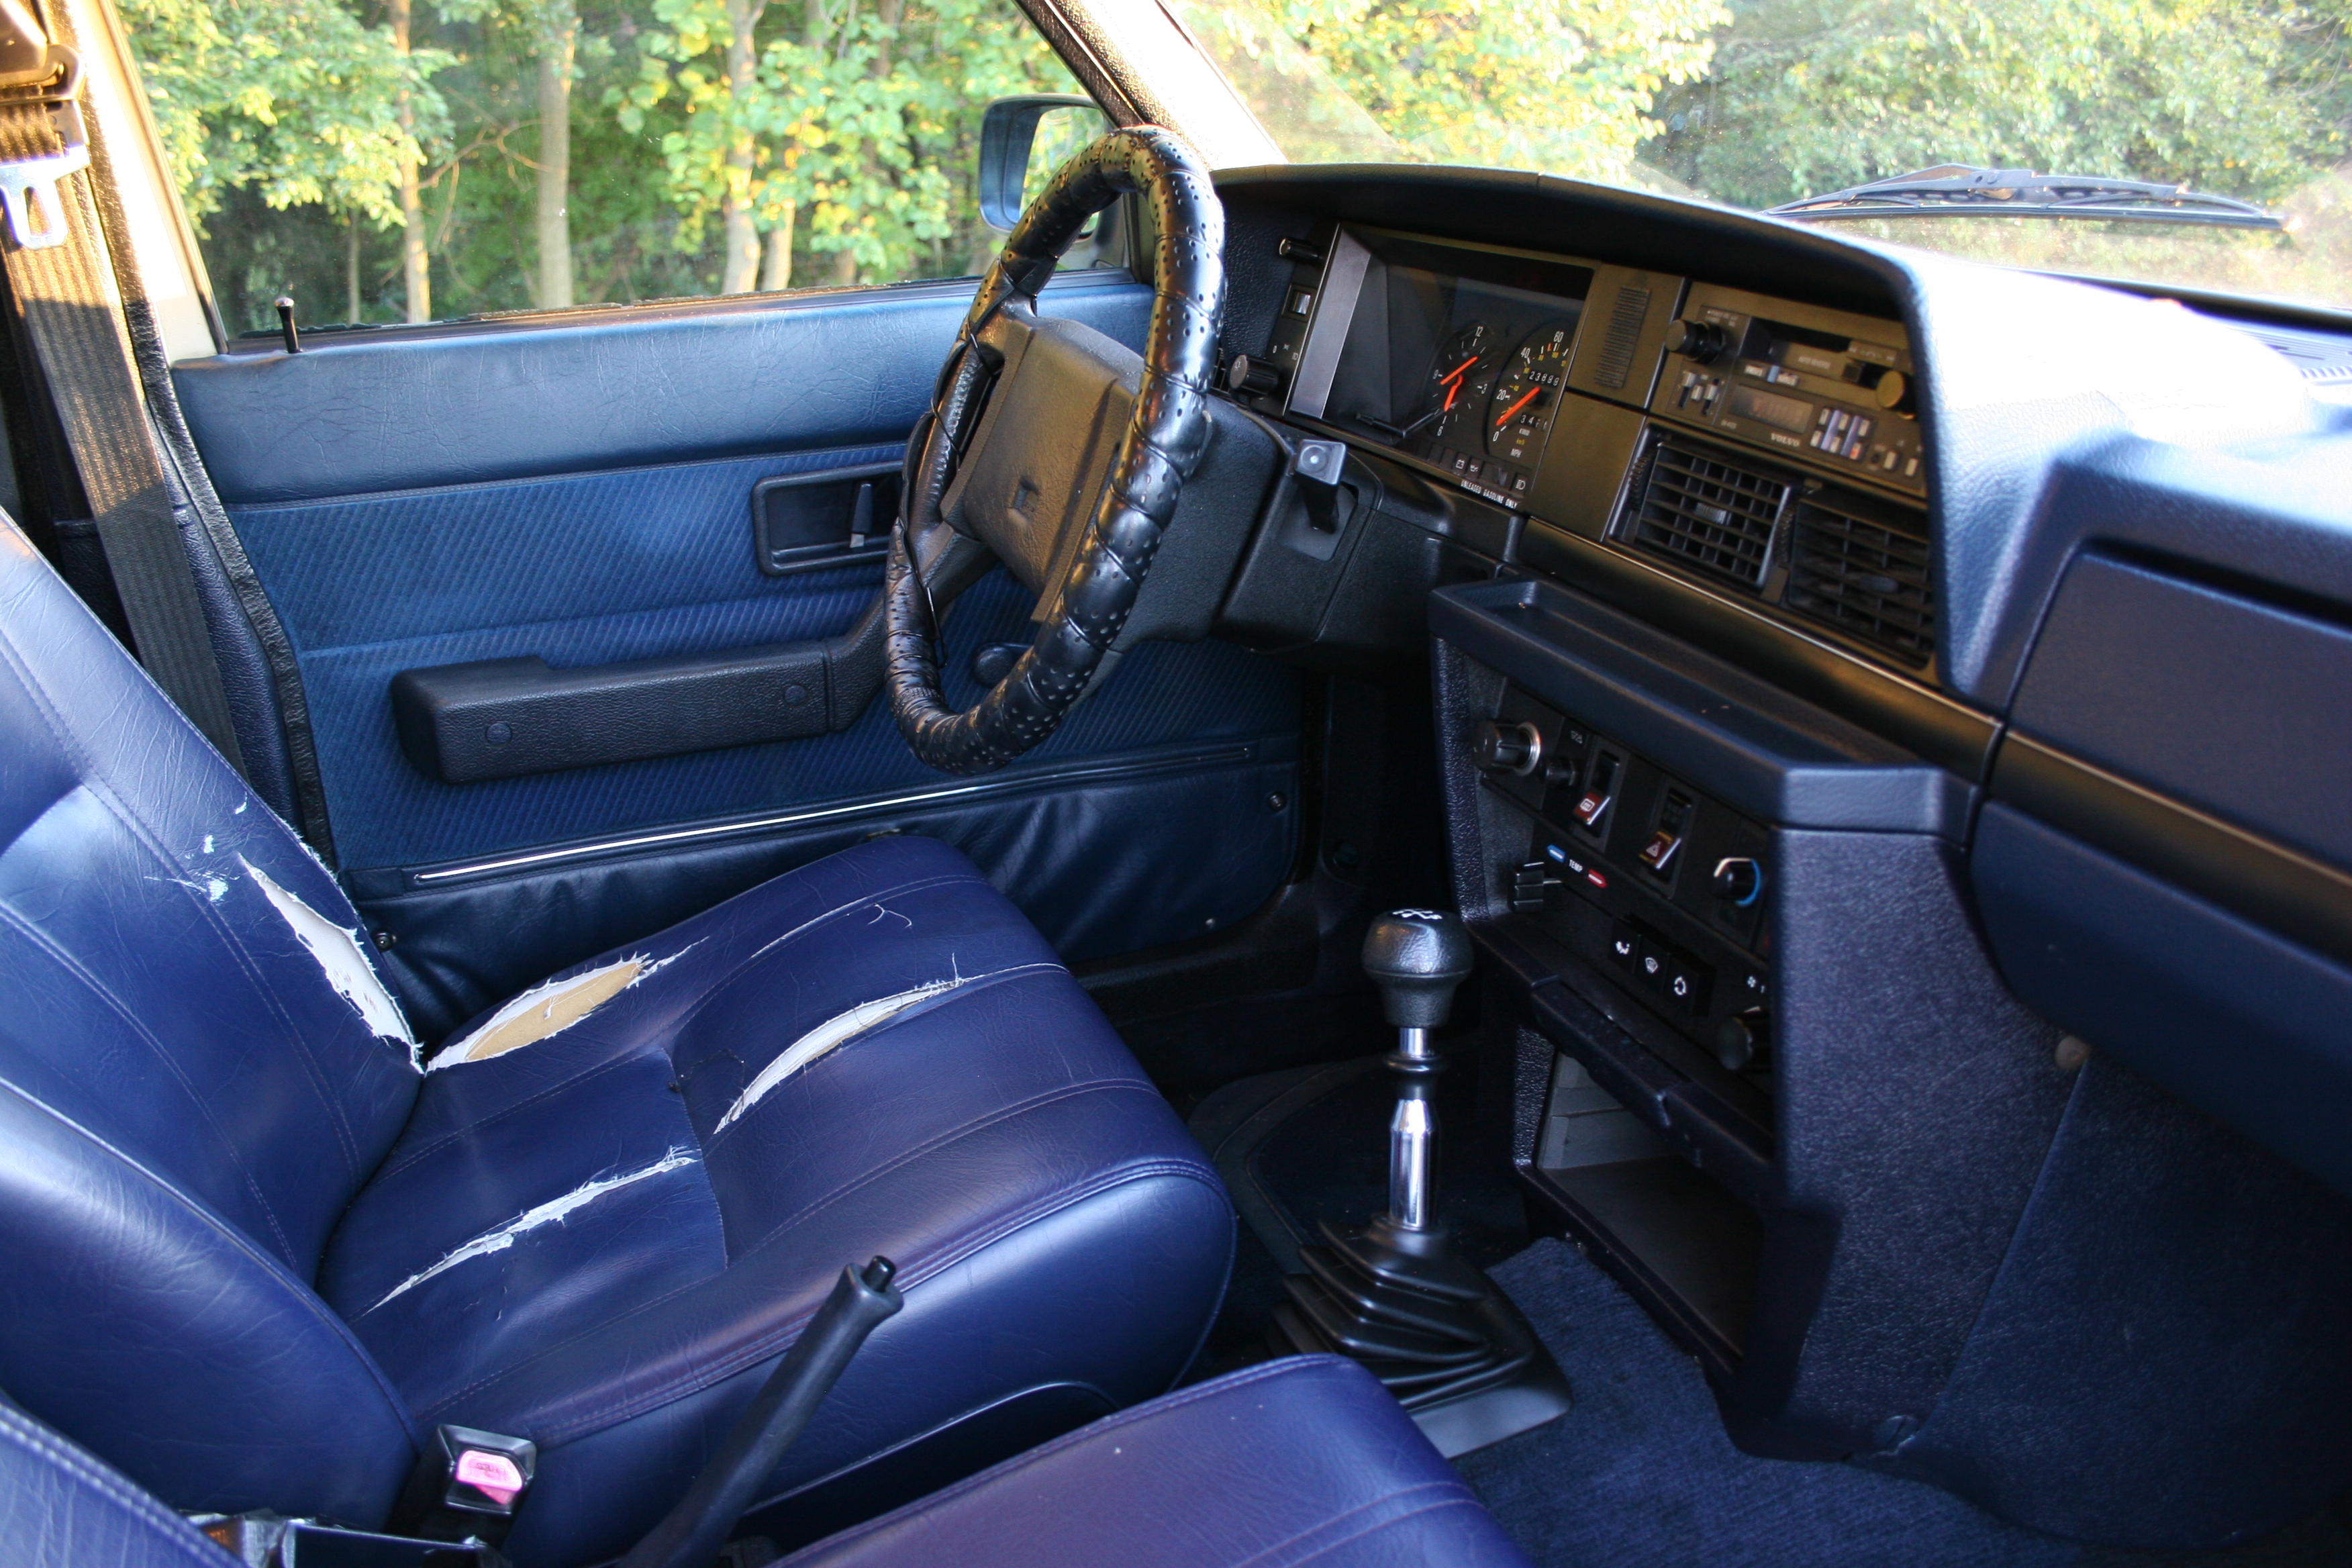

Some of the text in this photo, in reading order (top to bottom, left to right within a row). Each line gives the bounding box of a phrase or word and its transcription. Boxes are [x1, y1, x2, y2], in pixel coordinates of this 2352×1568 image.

[1475, 325, 1483, 337] 12
[1553, 331, 1564, 343] 60
[1520, 347, 1530, 358] 40
[1481, 383, 1487, 394] 3
[1496, 389, 1506, 401] 20
[1437, 426, 1443, 436] 6
[1492, 431, 1500, 442] 0
[1771, 432, 1800, 447] VOLVO
[1510, 448, 1522, 458] MPH
[1461, 479, 1518, 509] UNLEADED GASOLINE ONLY
[1569, 859, 1583, 873] TEMP
